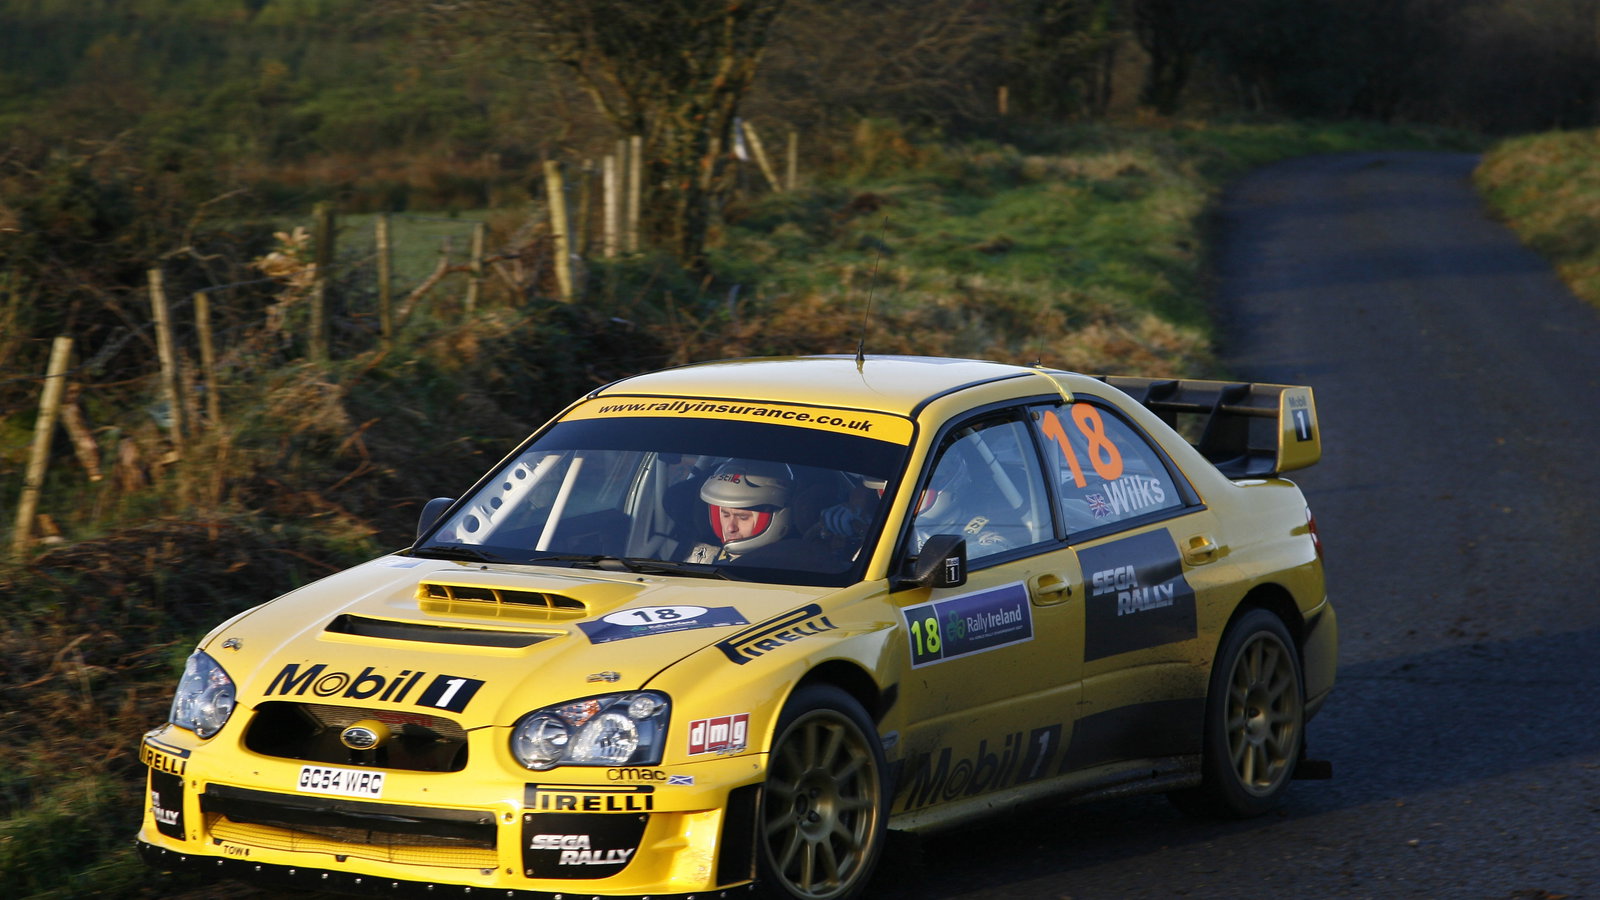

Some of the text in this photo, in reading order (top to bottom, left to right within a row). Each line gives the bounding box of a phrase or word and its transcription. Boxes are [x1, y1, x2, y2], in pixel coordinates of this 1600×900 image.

[598, 400, 873, 433] www.rallyinsurance.co.uk
[1041, 402, 1124, 489] 18
[1103, 475, 1166, 516] Wilks
[1092, 564, 1138, 597] SEGA
[632, 608, 682, 623] 18
[1117, 583, 1174, 617] RALLY
[714, 603, 839, 666] PIRELLI
[910, 617, 941, 656] 18
[263, 664, 426, 703] Mobil
[691, 720, 746, 747] dmg
[300, 768, 382, 793] GC54 WRC
[606, 768, 667, 781] cmac
[904, 731, 1024, 811] Mobil
[524, 783, 655, 811] PIRELLI
[530, 834, 592, 850] SEGA
[558, 848, 635, 866] RALLY
